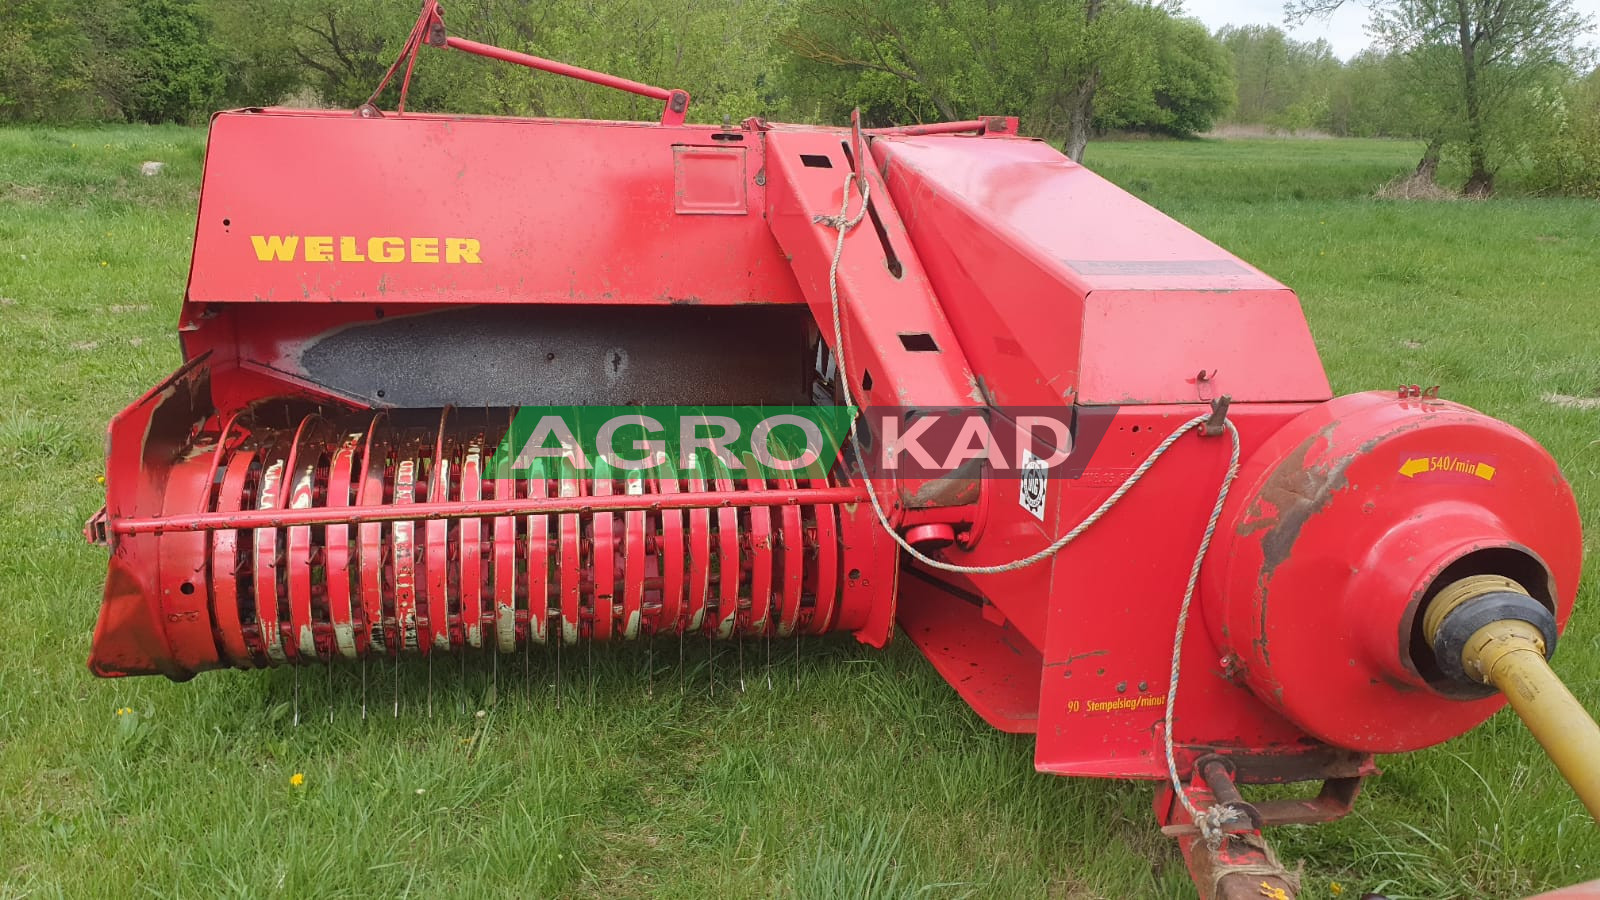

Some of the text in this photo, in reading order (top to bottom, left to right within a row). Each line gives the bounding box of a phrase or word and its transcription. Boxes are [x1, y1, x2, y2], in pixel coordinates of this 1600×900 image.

[250, 235, 482, 264] WELGER
[1430, 455, 1476, 474] 540/min
[1067, 700, 1080, 713] 90
